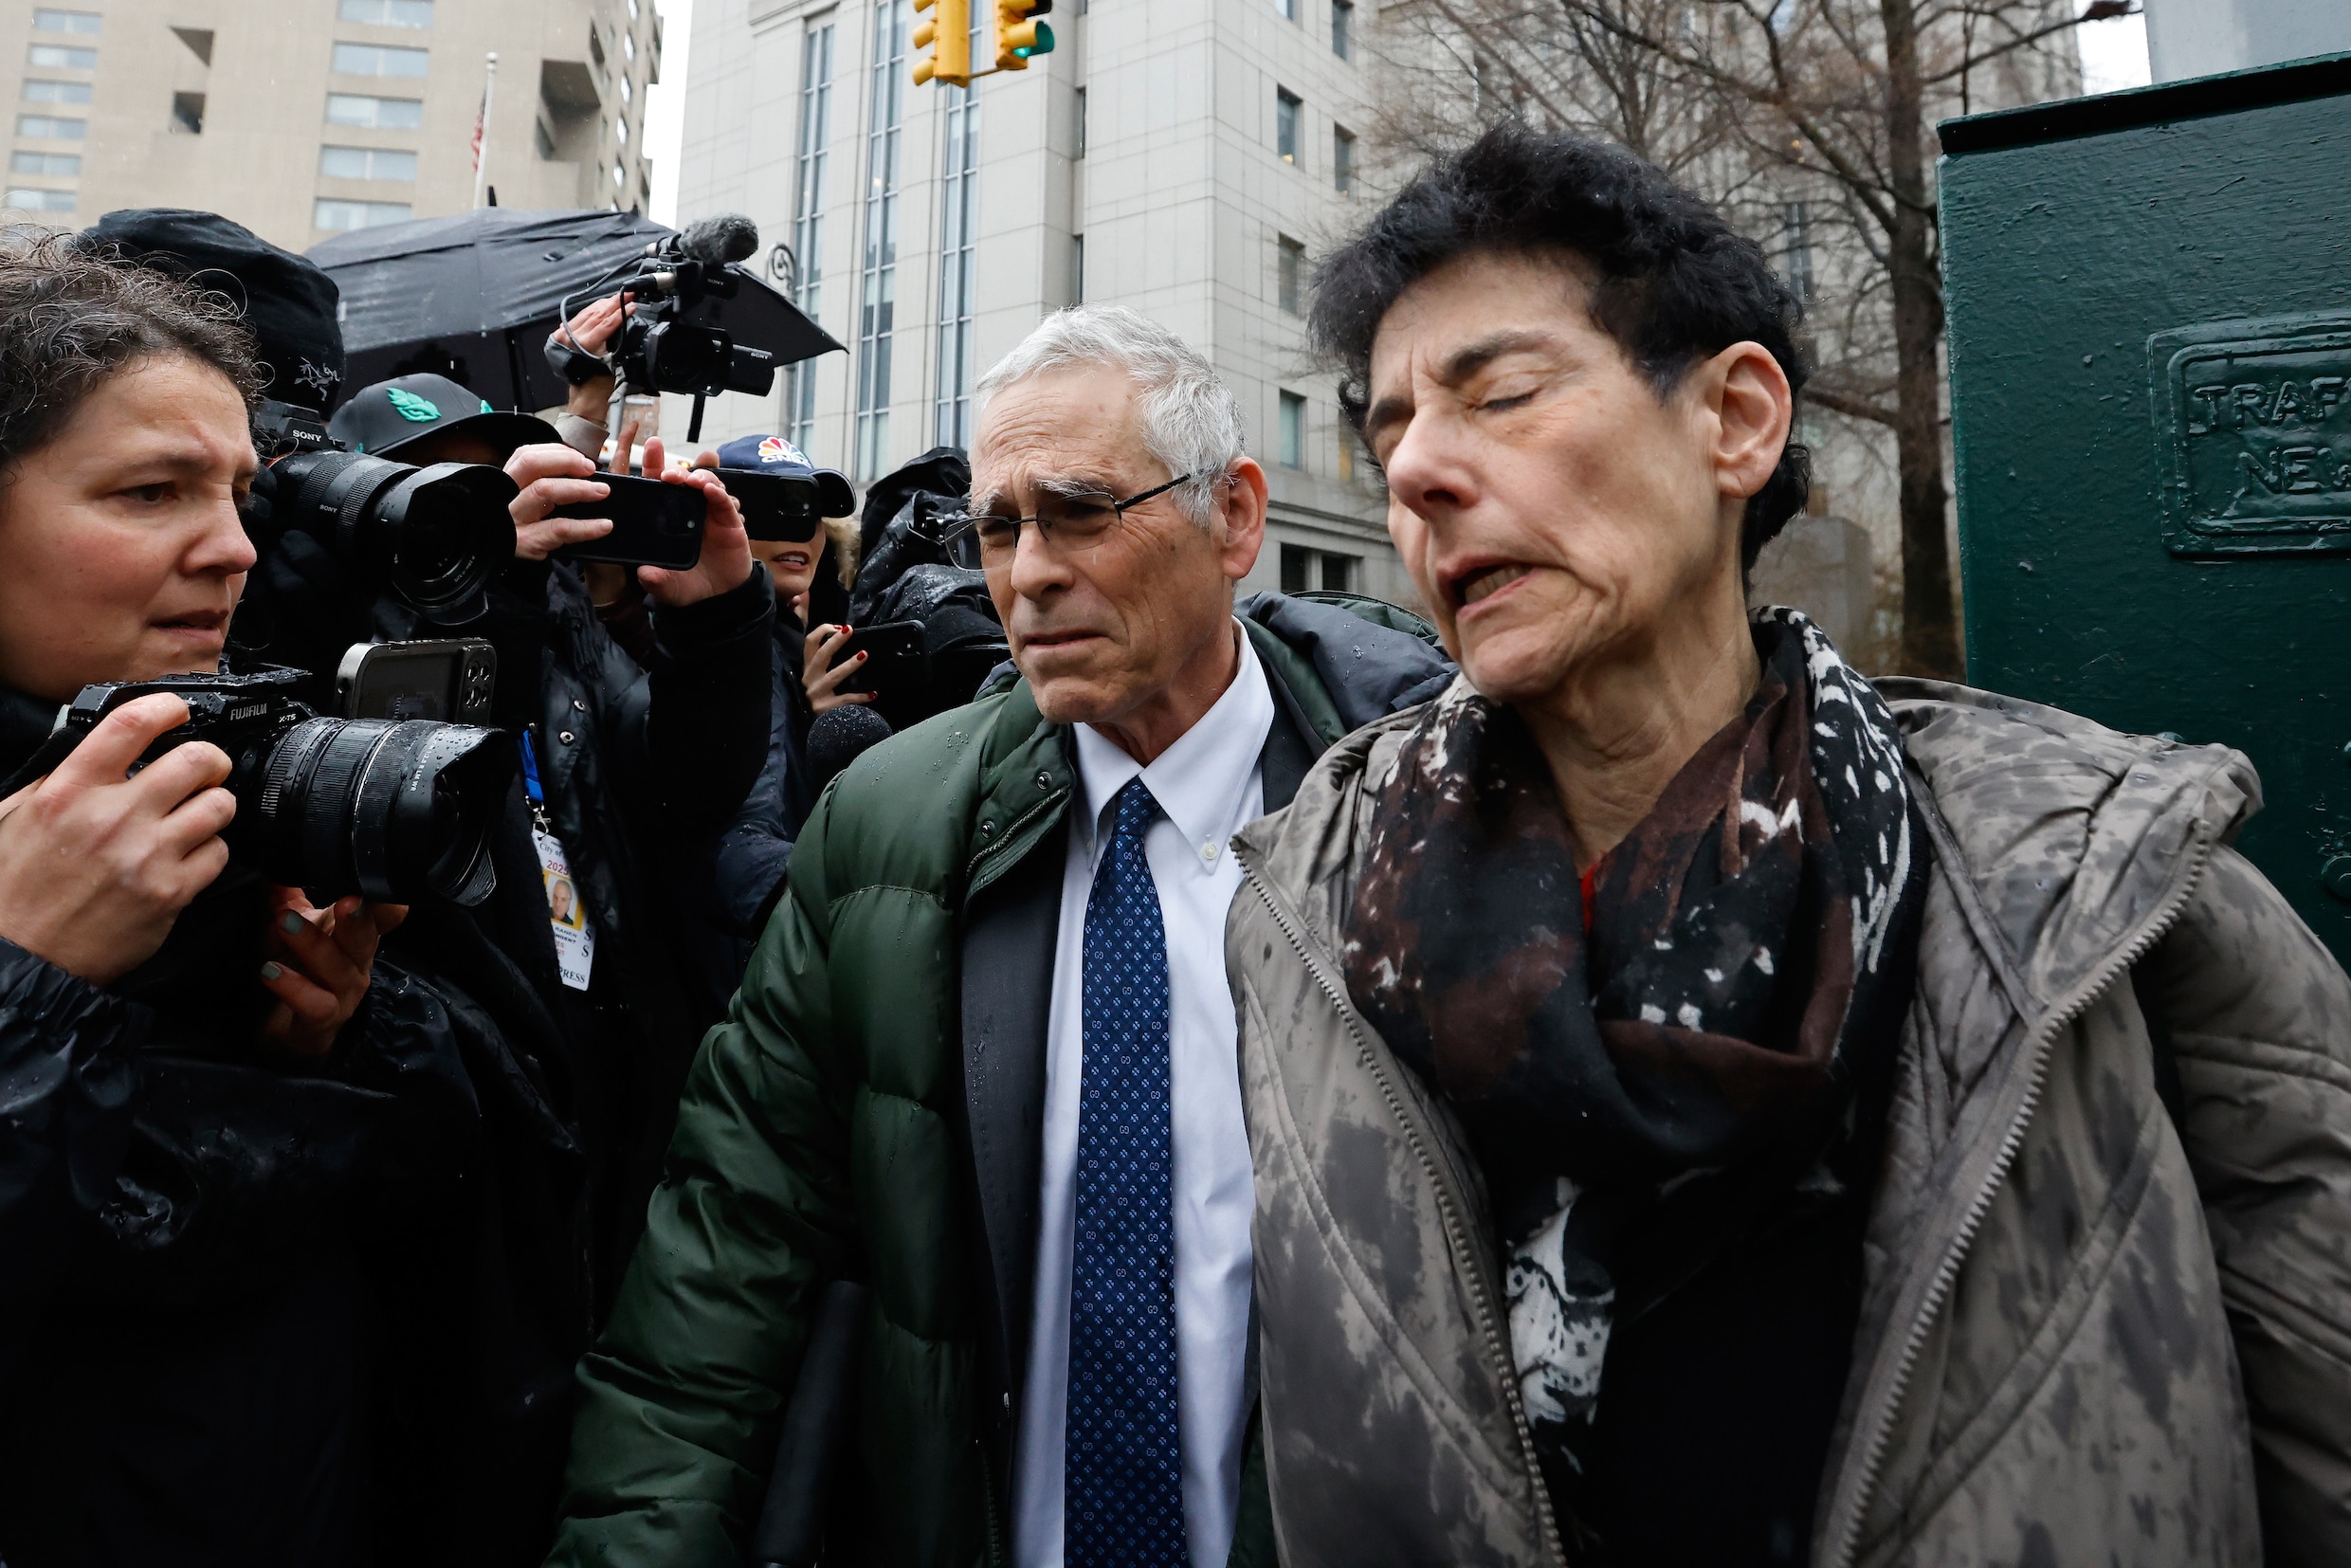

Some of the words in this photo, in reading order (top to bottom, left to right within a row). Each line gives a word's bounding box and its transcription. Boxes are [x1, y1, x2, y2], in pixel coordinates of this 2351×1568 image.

[750, 352, 769, 360] SONY
[2194, 377, 2351, 427] TRAF
[292, 429, 322, 442] SONY
[319, 503, 338, 513] SONY
[229, 702, 267, 720] FUJIFILM
[279, 713, 297, 722] X-T5
[539, 842, 554, 854] City
[547, 860, 570, 876] 2025
